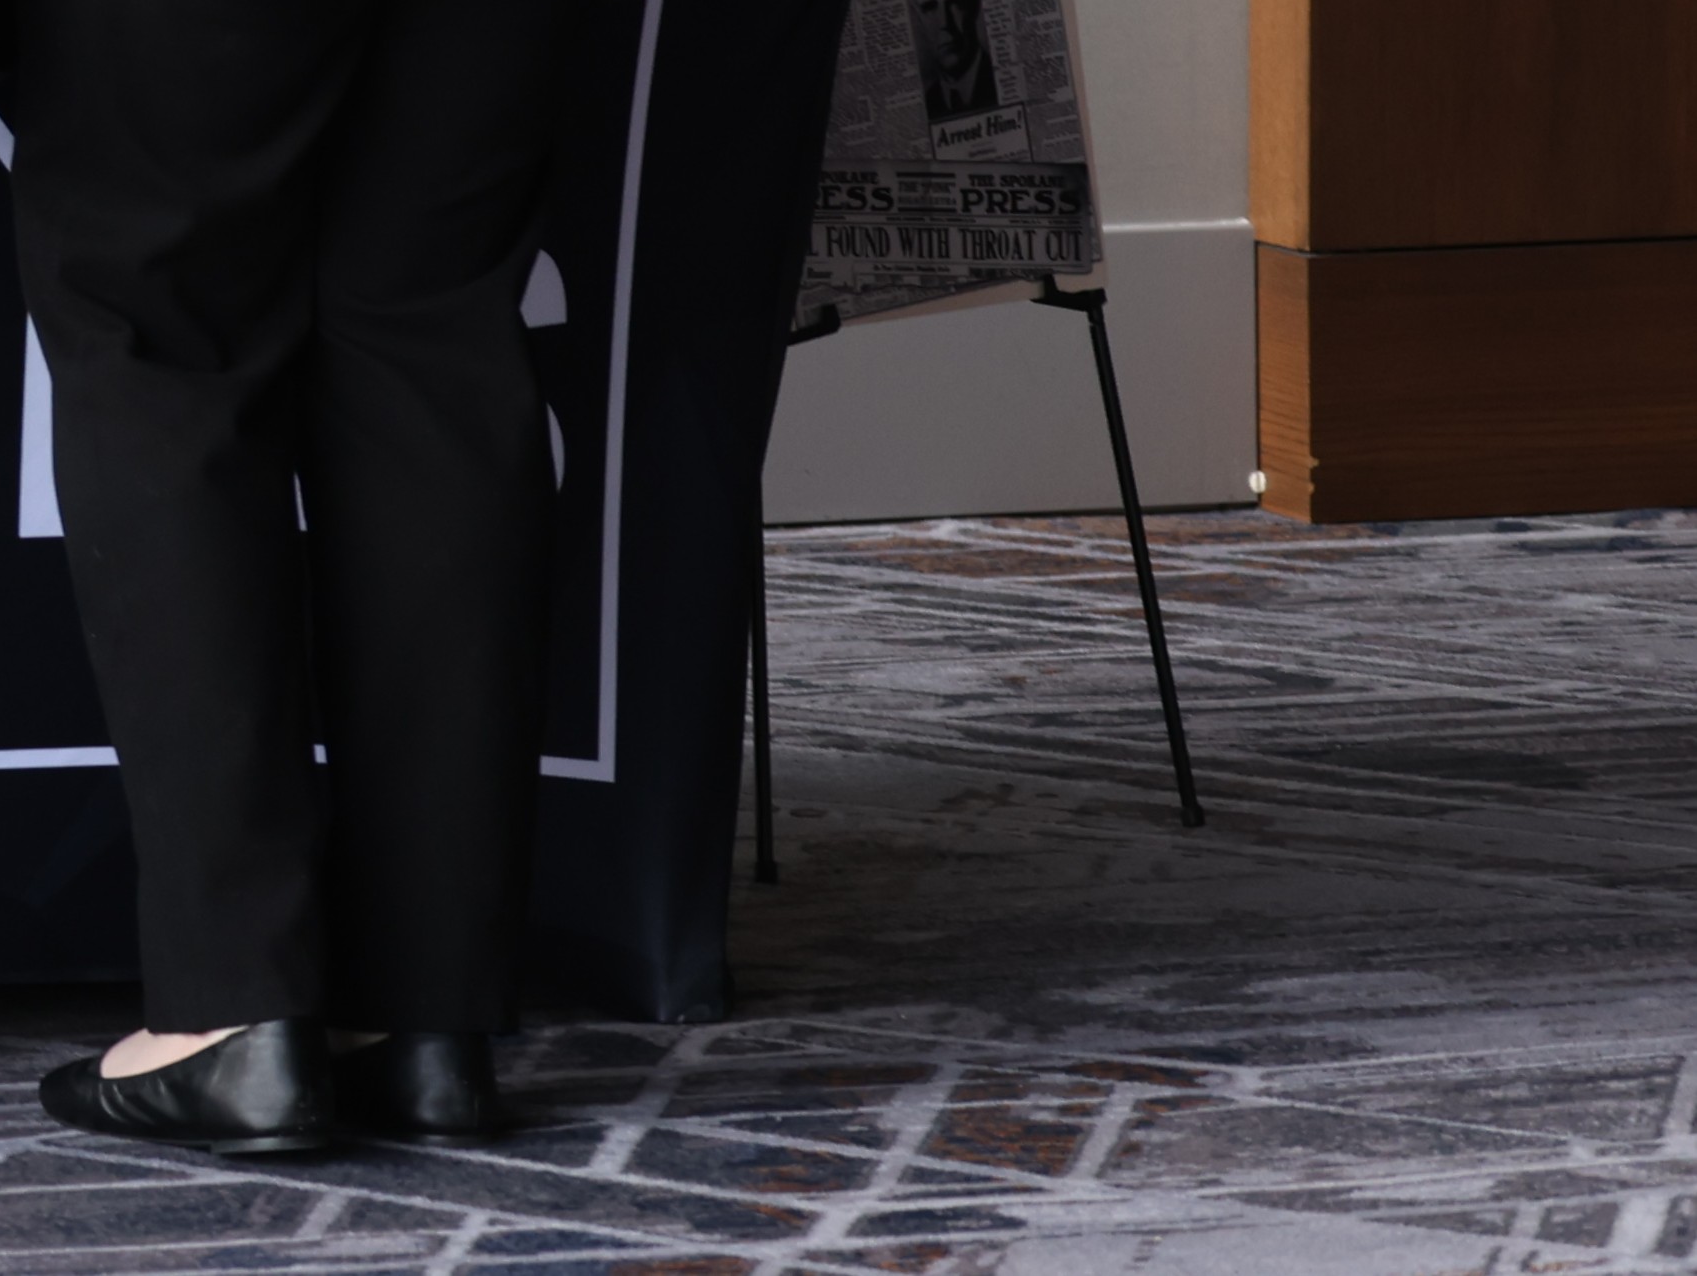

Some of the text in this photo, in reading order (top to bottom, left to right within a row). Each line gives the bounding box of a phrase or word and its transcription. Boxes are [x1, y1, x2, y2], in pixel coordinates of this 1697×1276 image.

[936, 109, 1023, 148] Arrest Him!
[968, 174, 1065, 188] THE SPOKANE
[819, 186, 1083, 216] ESS PRESS
[824, 226, 892, 259] FOUND
[895, 227, 951, 260] WITH
[958, 228, 1036, 261] THROAT
[1045, 229, 1084, 262] CUT
